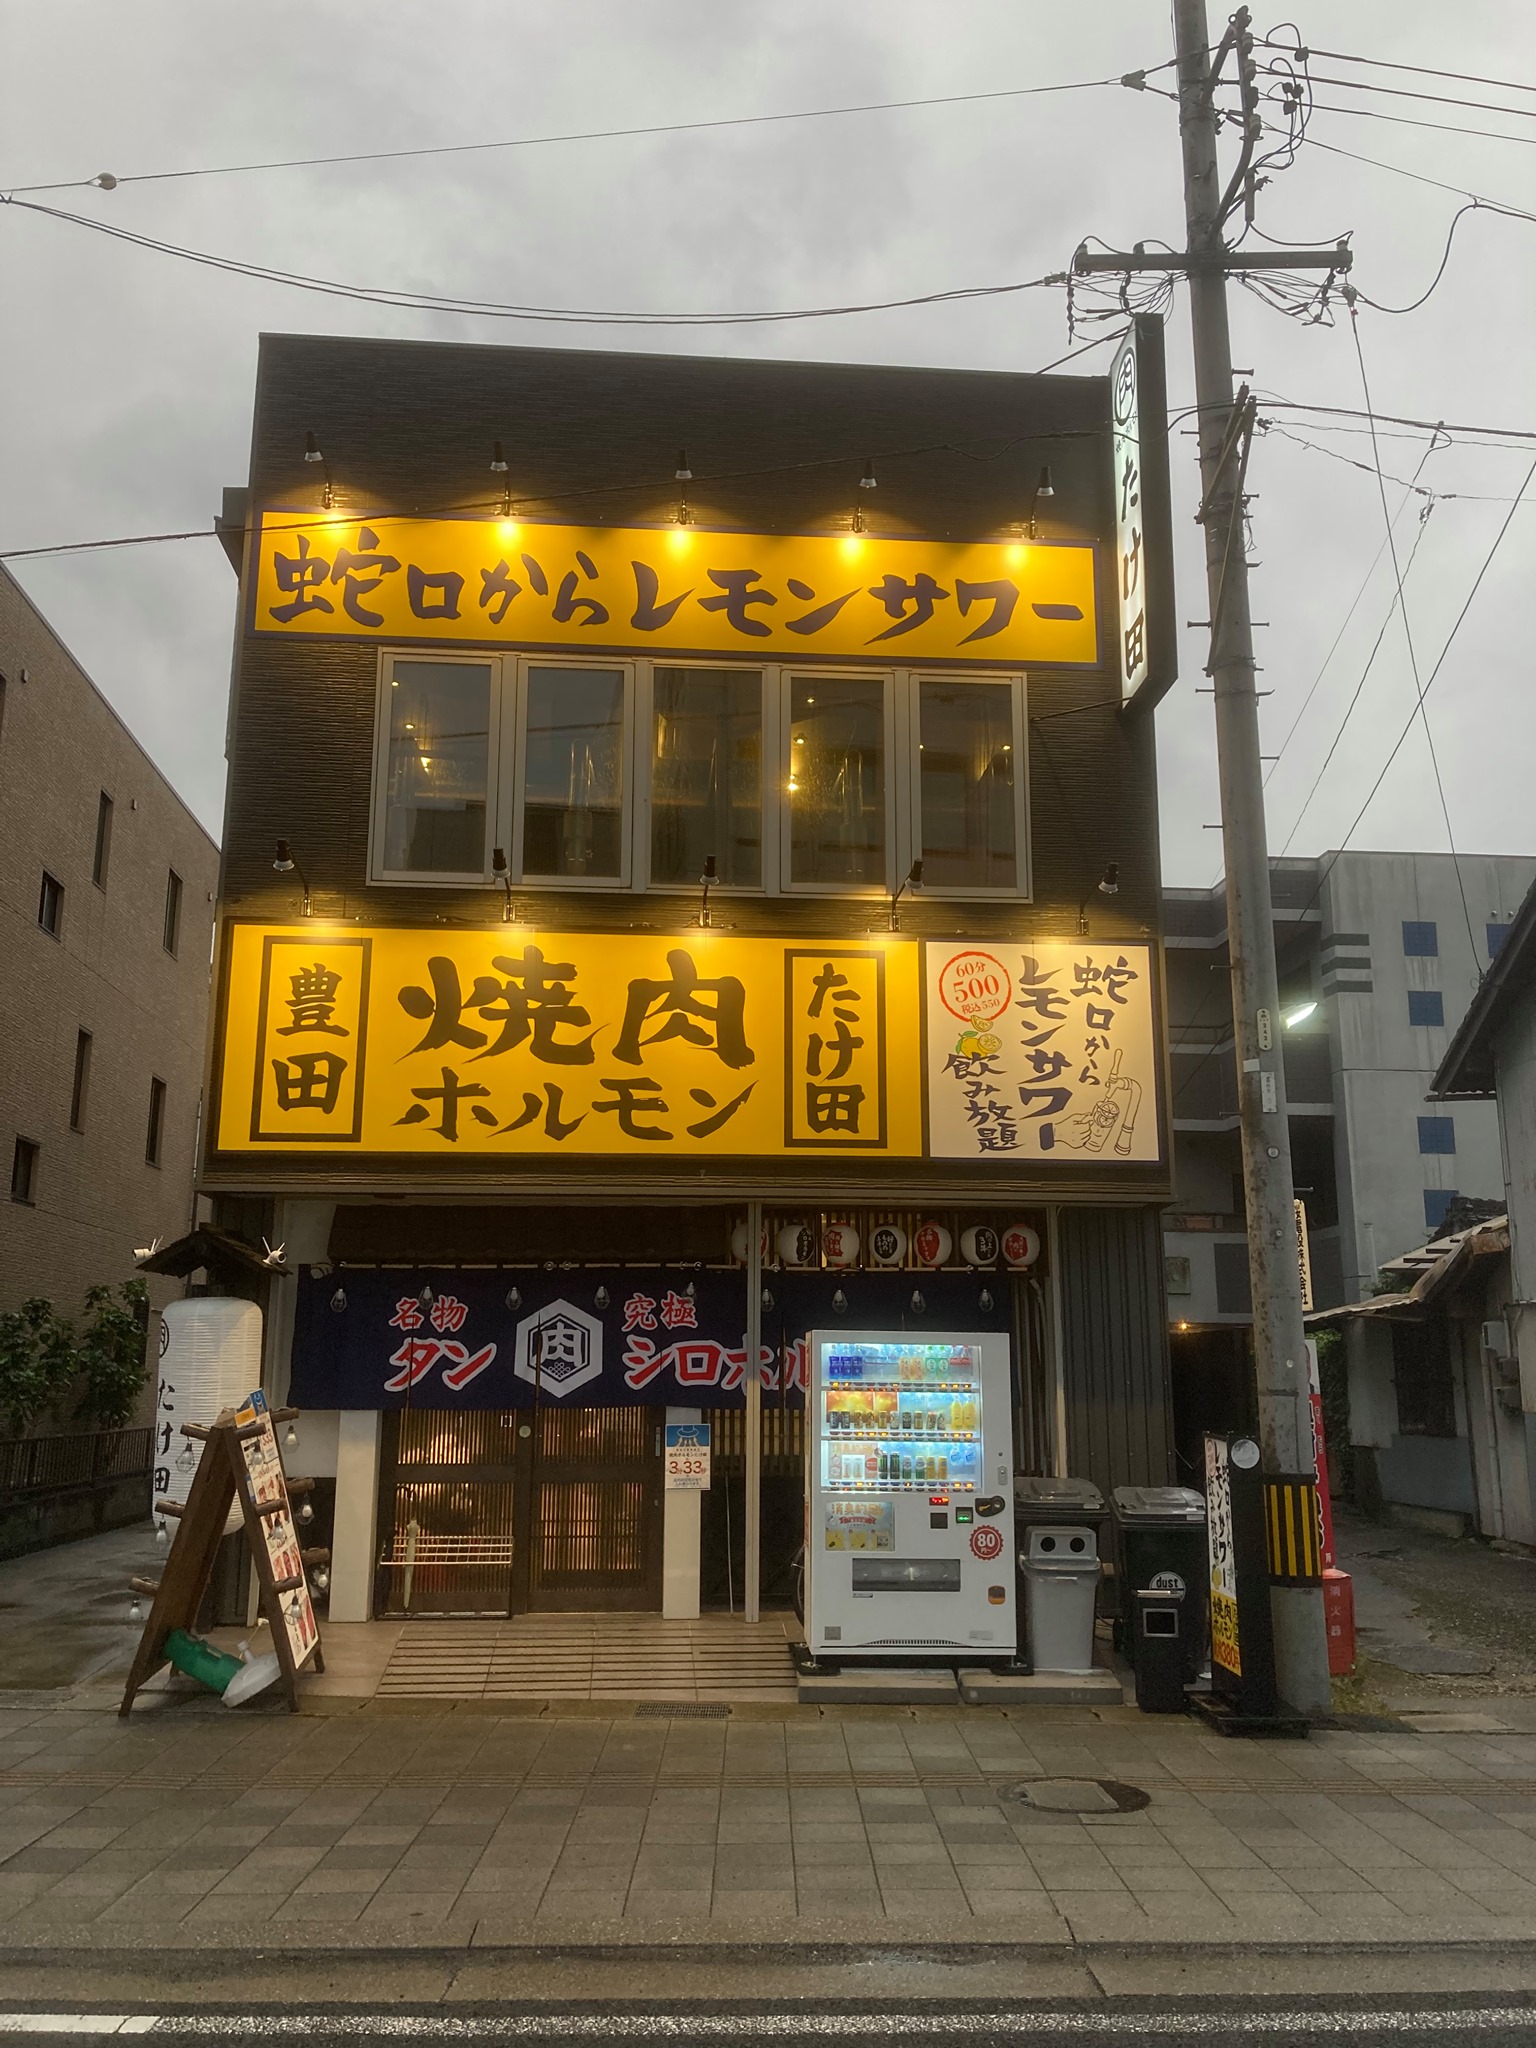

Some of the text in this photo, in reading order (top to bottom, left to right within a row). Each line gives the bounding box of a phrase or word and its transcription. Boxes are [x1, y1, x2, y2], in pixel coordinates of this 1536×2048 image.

[269, 526, 1084, 647] 蛇口からレモンサワー
[1121, 453, 1145, 681] たけ田
[394, 944, 755, 1070] 焼肉
[953, 974, 999, 1003] 500
[956, 961, 986, 978] 60分
[1069, 955, 1139, 1086] 蛇口から
[271, 963, 350, 1114] 豊田
[806, 961, 865, 1134] たけ田
[1015, 954, 1074, 1151] レモンサワー
[390, 1066, 759, 1141] ホルモン
[941, 1051, 1028, 1154] 飲み放題
[389, 1294, 468, 1333] 名物
[622, 1291, 698, 1332] 究極
[384, 1336, 497, 1391] タン
[978, 1534, 995, 1547] 80
[1214, 1441, 1226, 1588] レモンサワー
[1156, 1576, 1178, 1588] dust
